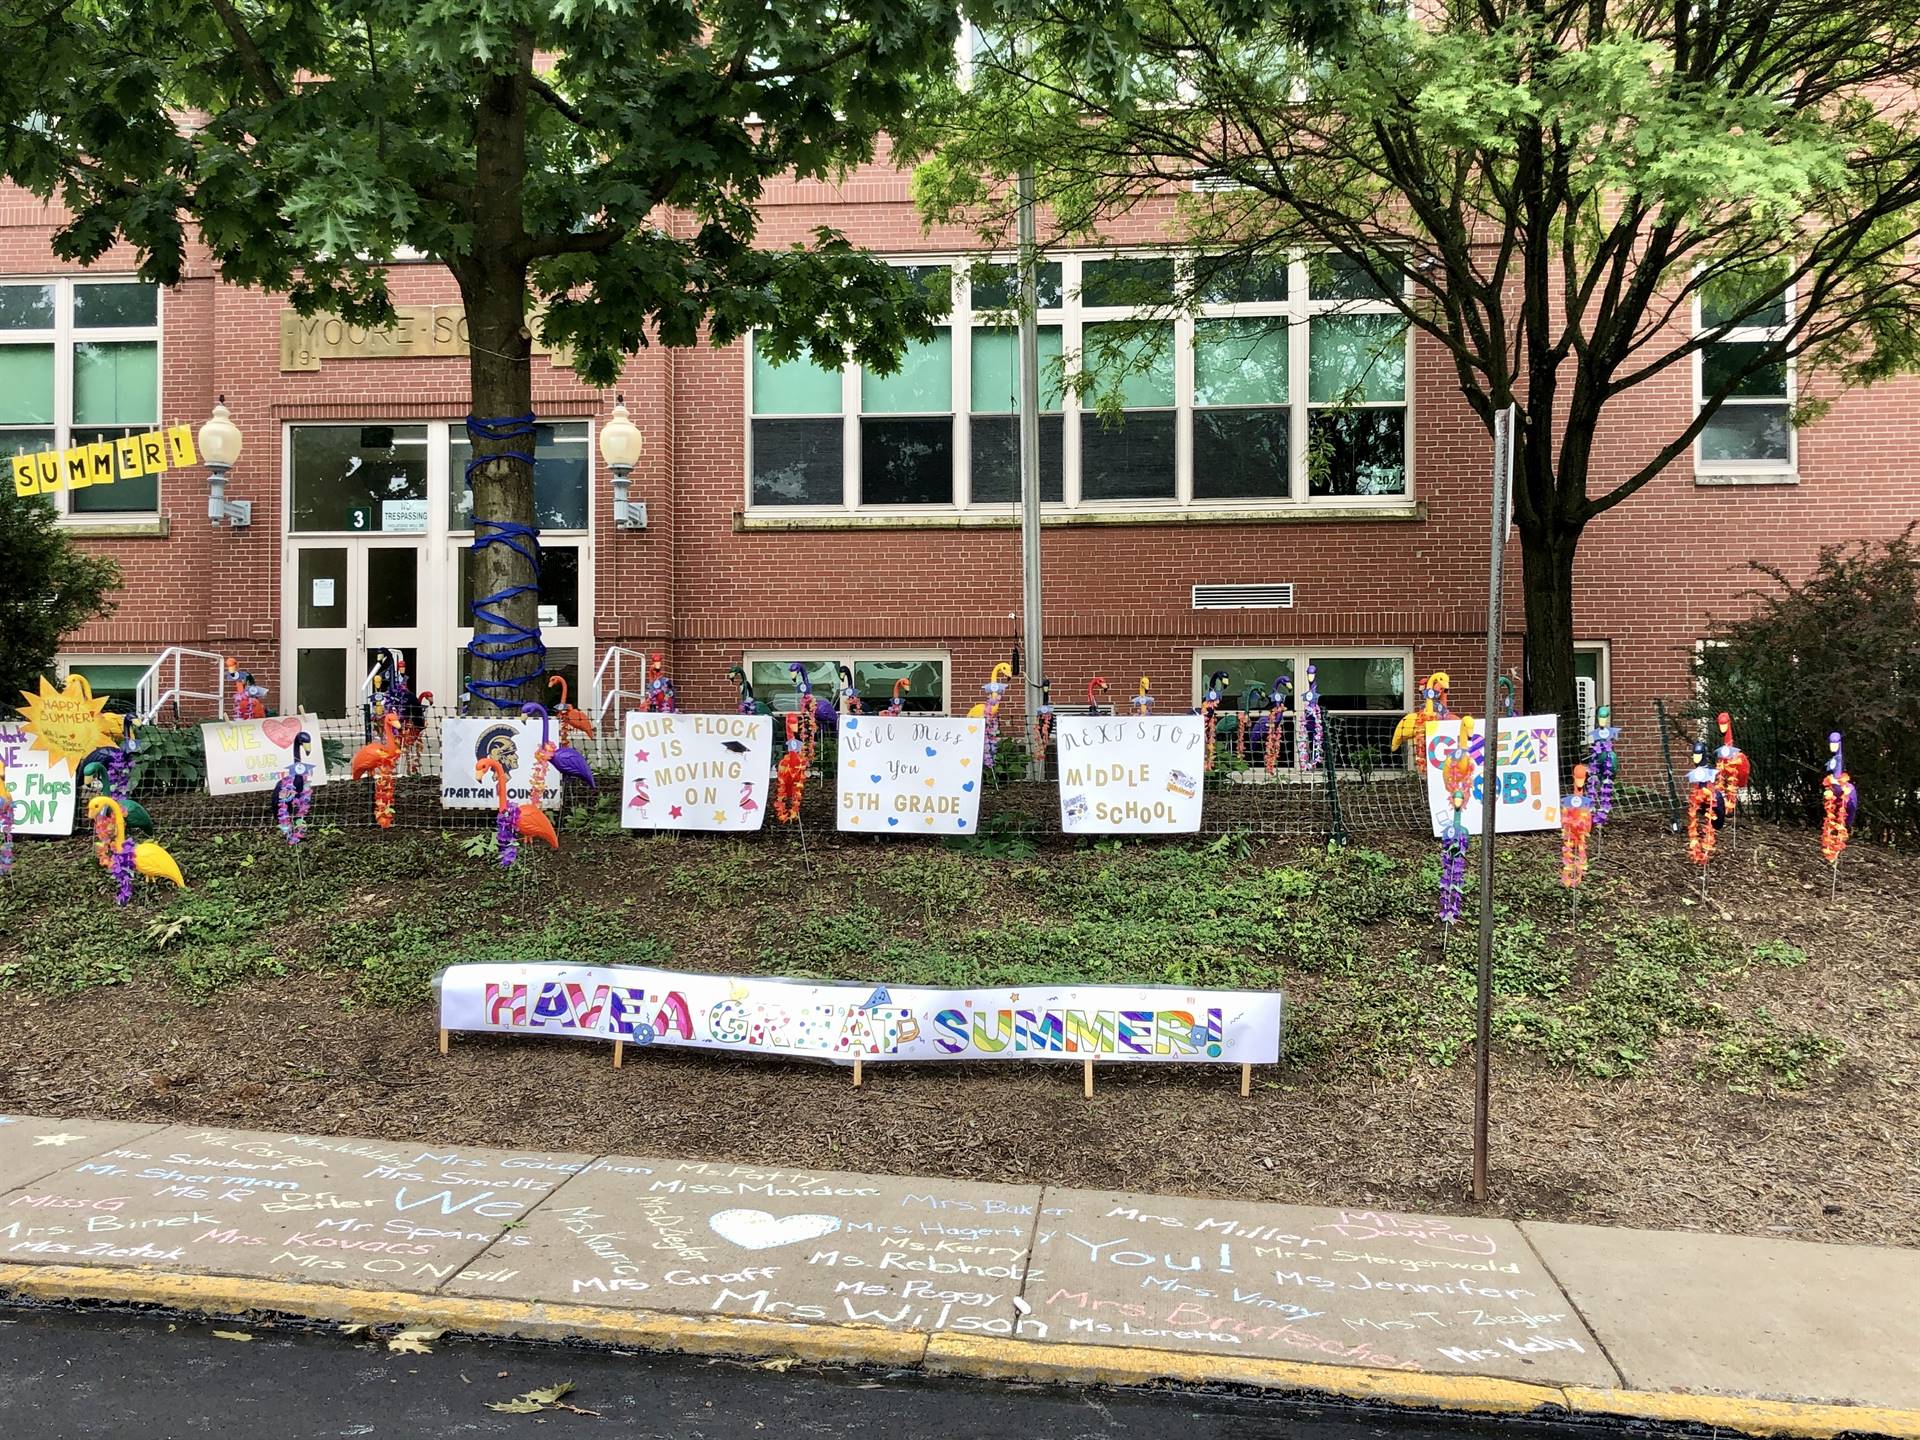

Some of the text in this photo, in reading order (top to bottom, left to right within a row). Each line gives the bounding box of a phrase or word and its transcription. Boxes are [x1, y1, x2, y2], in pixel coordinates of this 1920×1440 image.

[19, 437, 184, 487] SUMMER!
[353, 510, 364, 528] 3
[384, 511, 428, 521] TRESPASSING
[40, 711, 95, 723] SUMMER!
[43, 700, 81, 712] HAPPY
[216, 725, 260, 752] WE
[631, 717, 760, 741] OUR FLOCK
[845, 723, 963, 752] We'll Miss
[1062, 722, 1201, 751] NEXT STOP
[660, 740, 683, 758] IS
[245, 754, 278, 769] OUR
[887, 760, 920, 780] You
[655, 761, 742, 787] MOVING
[1066, 764, 1149, 787] MIDDLE
[25, 773, 72, 799] Flops
[444, 787, 494, 799] SPARTAN
[685, 787, 717, 806] ON
[843, 792, 960, 814] 5TH GRADE
[1096, 801, 1176, 824] SCHOOL
[485, 982, 645, 1034] HAVE
[651, 991, 697, 1041] A
[932, 1007, 1223, 1058] SUMMER!
[135, 1167, 300, 1191] Sherman
[431, 1171, 556, 1191] Smeltz
[650, 1180, 733, 1195] Miss
[728, 1167, 828, 1188] Patty
[8, 1194, 133, 1212] Miss G
[395, 1186, 525, 1216] We
[984, 1200, 1074, 1215] Baker
[1339, 1210, 1451, 1231] Miss
[282, 1231, 437, 1256] Kovacs
[1193, 1218, 1328, 1247] Miller
[931, 1240, 1028, 1262] Kerry
[1066, 1232, 1235, 1274] You!
[270, 1251, 520, 1284] Mrs O'Neill
[902, 1280, 1003, 1307] Peggy
[1349, 1271, 1536, 1299] Jennifer
[711, 1287, 1049, 1338] Mrs Wilson
[1496, 1334, 1586, 1354] Kelly
